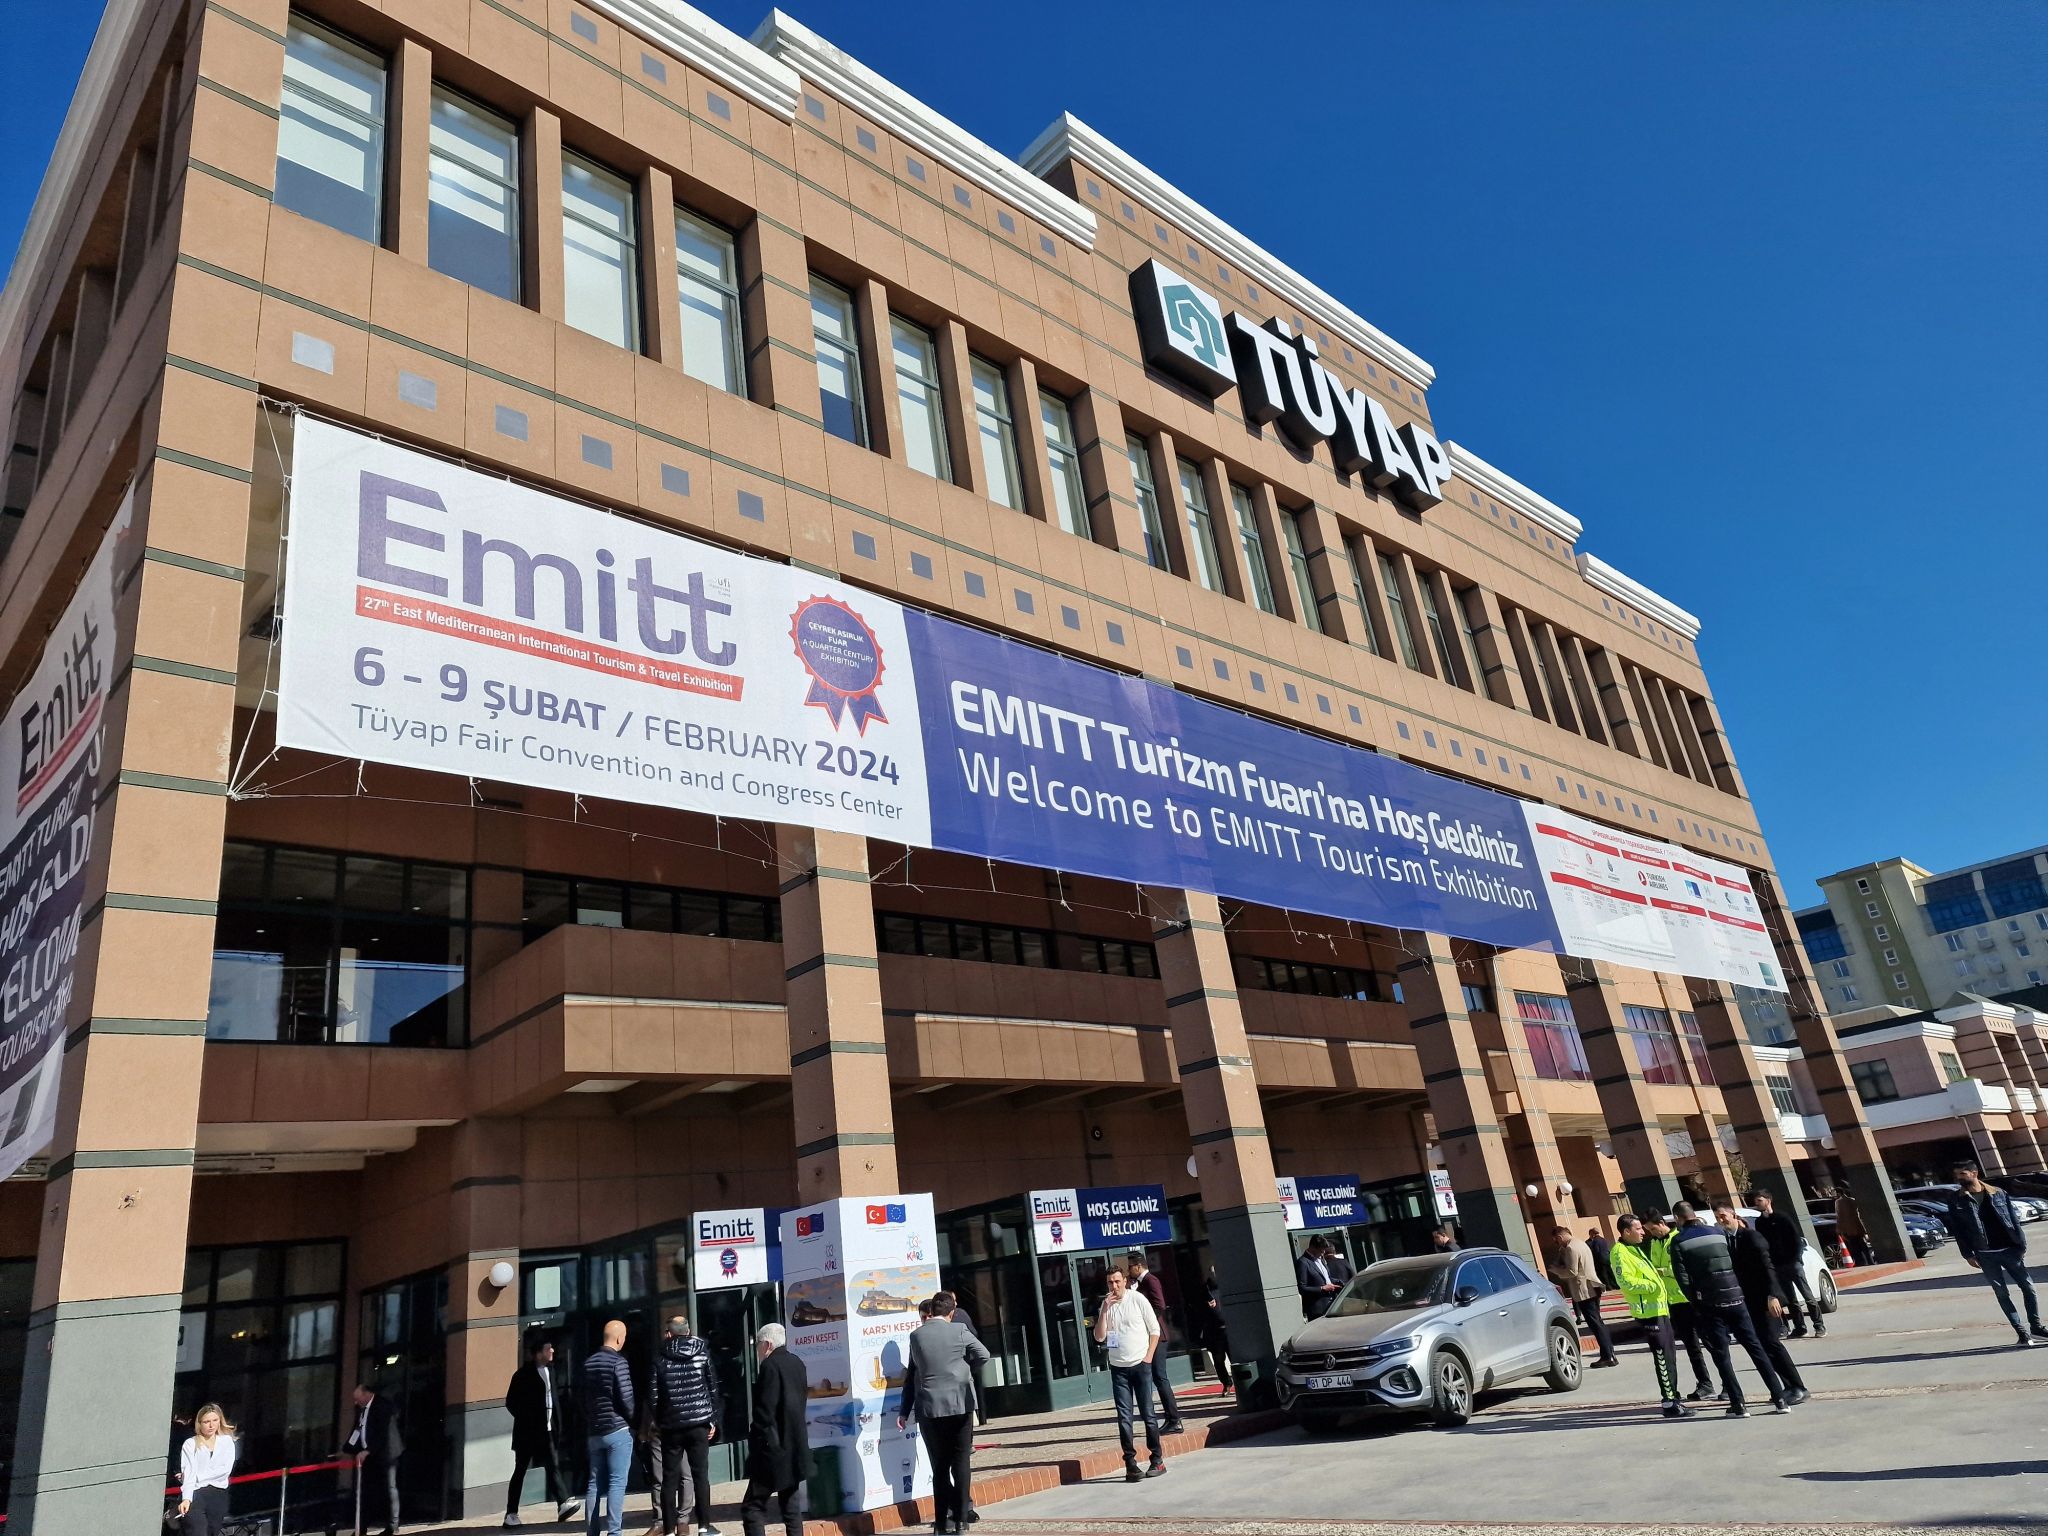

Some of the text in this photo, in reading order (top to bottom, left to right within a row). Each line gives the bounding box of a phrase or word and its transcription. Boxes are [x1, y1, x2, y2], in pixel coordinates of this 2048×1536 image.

[1229, 310, 1452, 504] TÜYAP
[357, 470, 738, 667] Emitt
[808, 621, 837, 635] ÇEYREK
[364, 596, 733, 693] 27th East Mediterranean International Tourism & Travel Exhibition
[809, 640, 842, 654] QUARTER
[843, 649, 874, 663] CENTURY
[828, 636, 848, 647] FUAR
[820, 652, 860, 669] EXHIBITION
[18, 610, 102, 793] Emitt
[354, 646, 386, 687] 6
[439, 663, 468, 703] 9
[483, 679, 606, 731] ŞUBAT
[615, 711, 633, 738] /
[645, 714, 808, 767] FEBRUARY
[814, 740, 900, 786] 2024
[351, 703, 904, 821] Tüyap Fair Convention and Congress Center
[951, 680, 1524, 869] EMITT Turizm Fuarı'na Hoş Geldiniz
[958, 748, 1154, 829] Welcome
[1164, 797, 1202, 838] to
[1210, 807, 1302, 863] EMITT
[1309, 832, 1428, 887] Tourism
[1430, 858, 1538, 911] Exhibition
[1277, 1182, 1292, 1197] itt
[1303, 1184, 1357, 1204] HOŞ GELDİNİZ
[1033, 1196, 1071, 1214] Emitt
[1086, 1201, 1110, 1220] HOŞ
[1111, 1195, 1159, 1215] GELDİNİZ
[1314, 1203, 1353, 1218] WELCOME
[699, 1217, 754, 1240] Emitt
[1101, 1219, 1152, 1237] WELCOME
[795, 1331, 839, 1346] KARS'I KEŞFET
[862, 1320, 921, 1337] KARS'I KEŞFE
